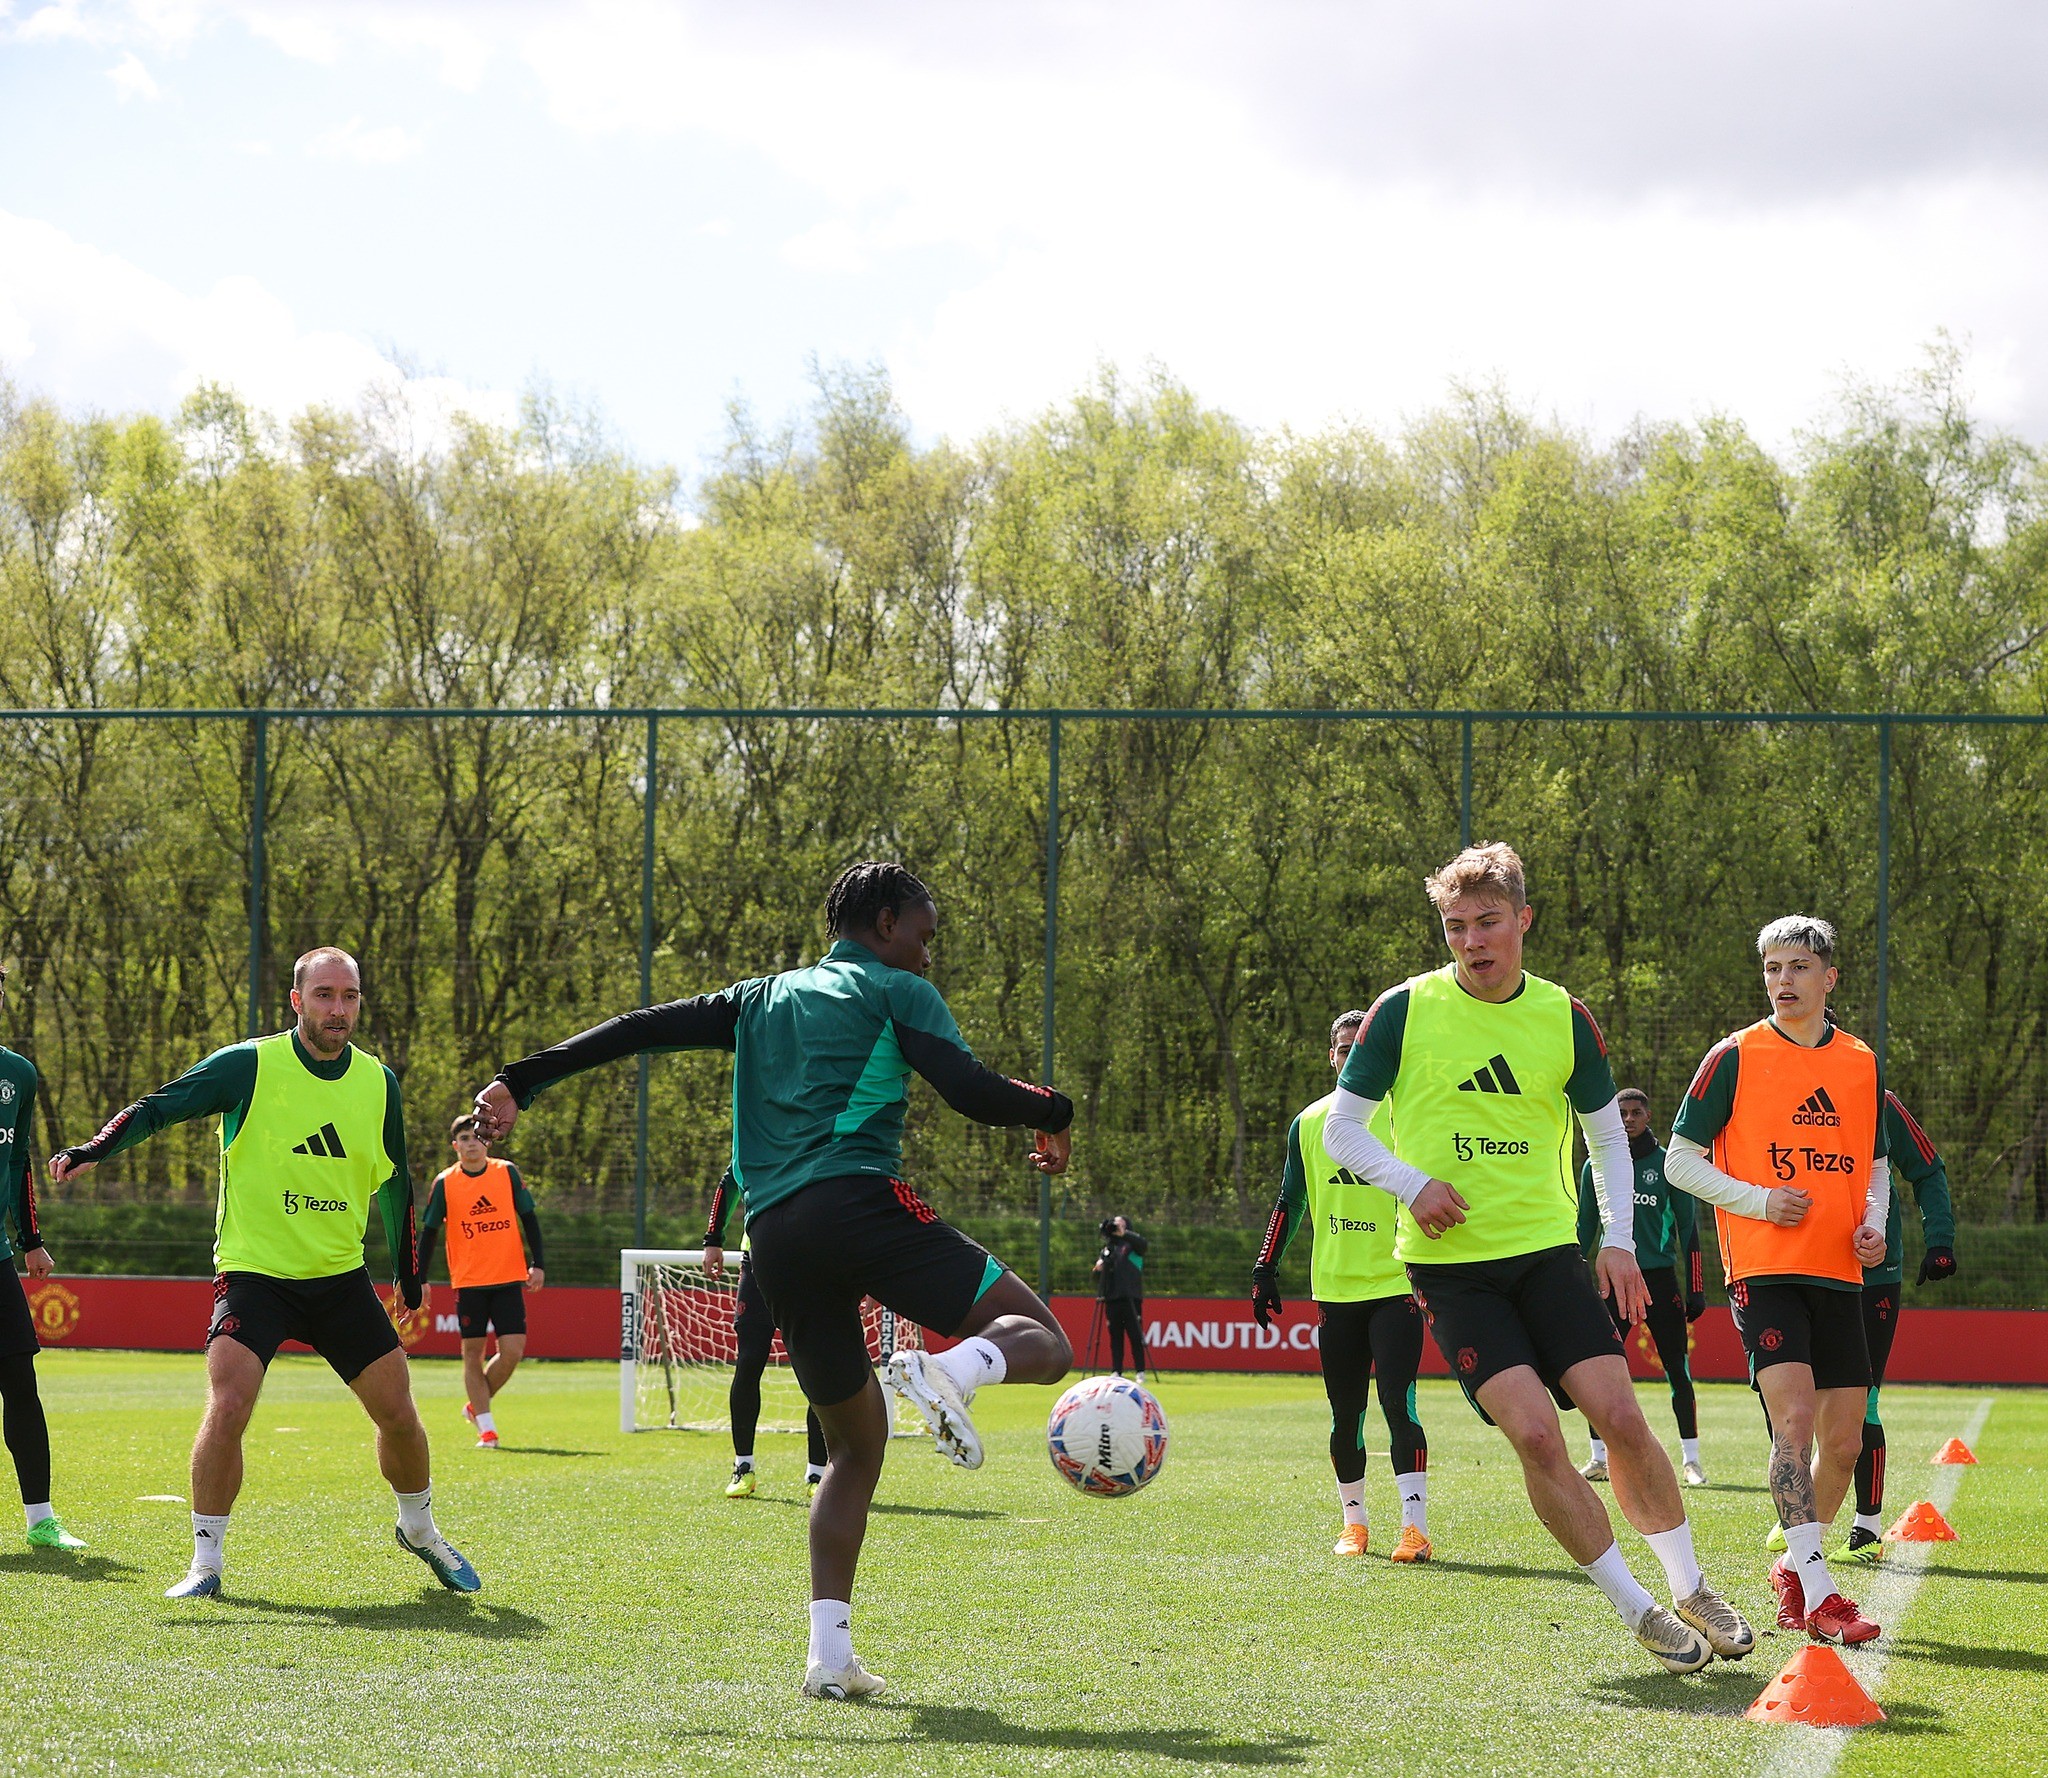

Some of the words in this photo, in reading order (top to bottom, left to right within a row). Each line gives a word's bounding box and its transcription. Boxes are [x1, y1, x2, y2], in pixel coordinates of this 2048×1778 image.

[1792, 1111, 1841, 1127] adidas
[1475, 1137, 1529, 1155] Tezos
[302, 1195, 348, 1212] Tezos
[474, 1219, 510, 1233] Tezos
[1339, 1218, 1376, 1232] Tezos
[622, 1294, 633, 1349] FORZA
[882, 1306, 892, 1354] ORZA
[1098, 1423, 1113, 1472] Mitre
